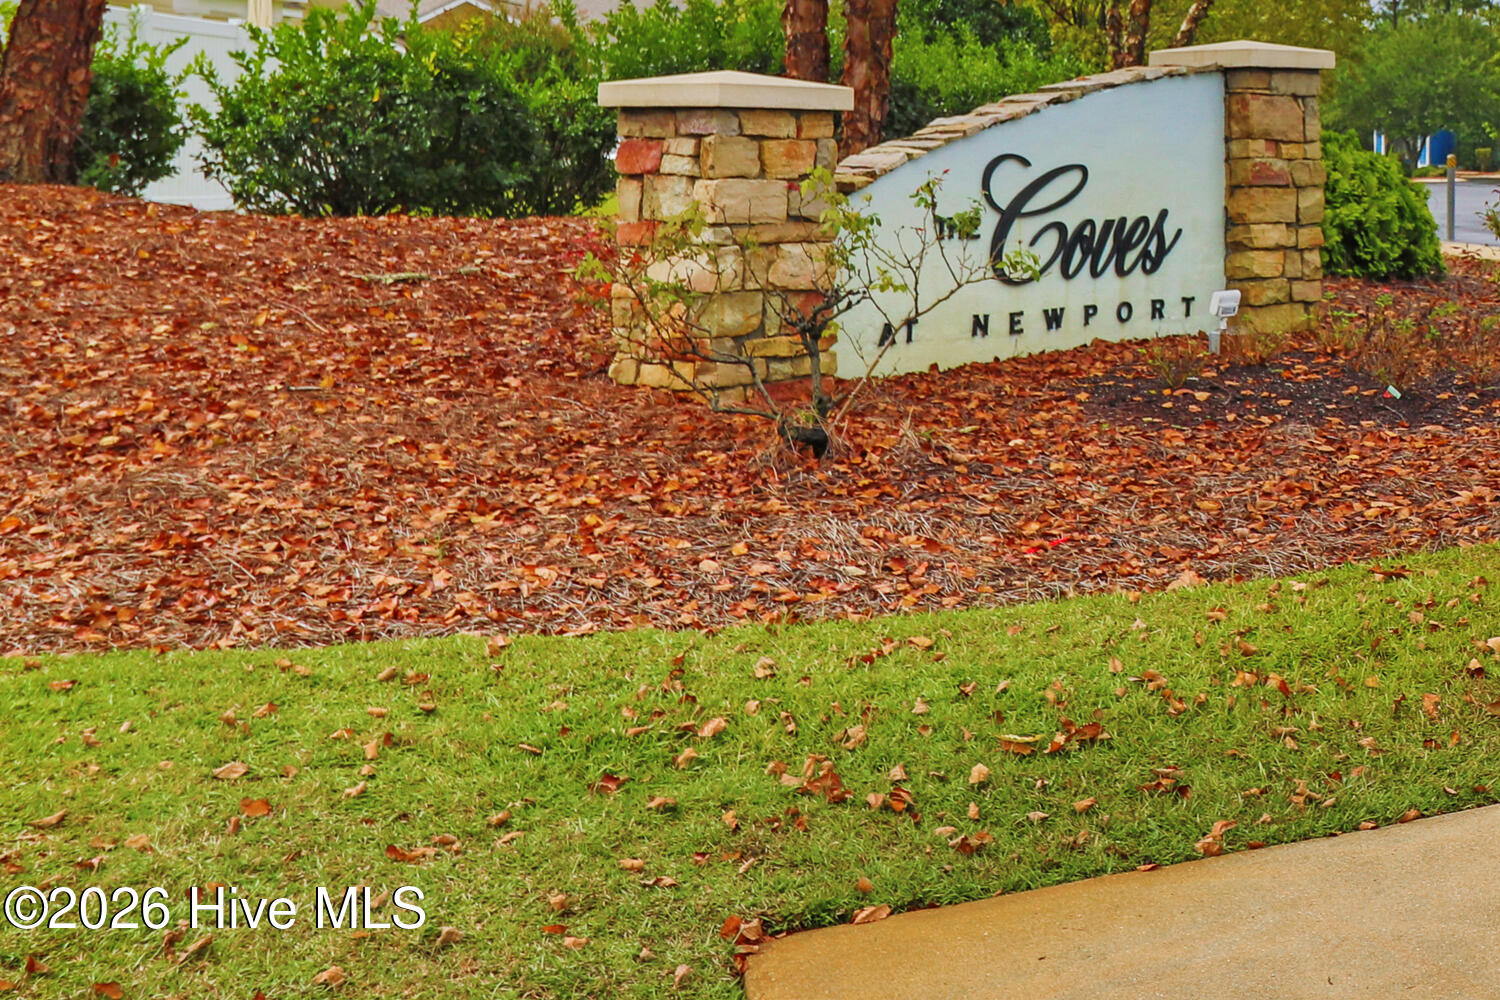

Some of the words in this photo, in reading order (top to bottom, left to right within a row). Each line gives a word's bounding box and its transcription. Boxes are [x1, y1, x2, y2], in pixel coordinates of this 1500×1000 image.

[982, 153, 1183, 286] Coves
[878, 318, 919, 347] AT
[971, 296, 1195, 338] NEWPORT
